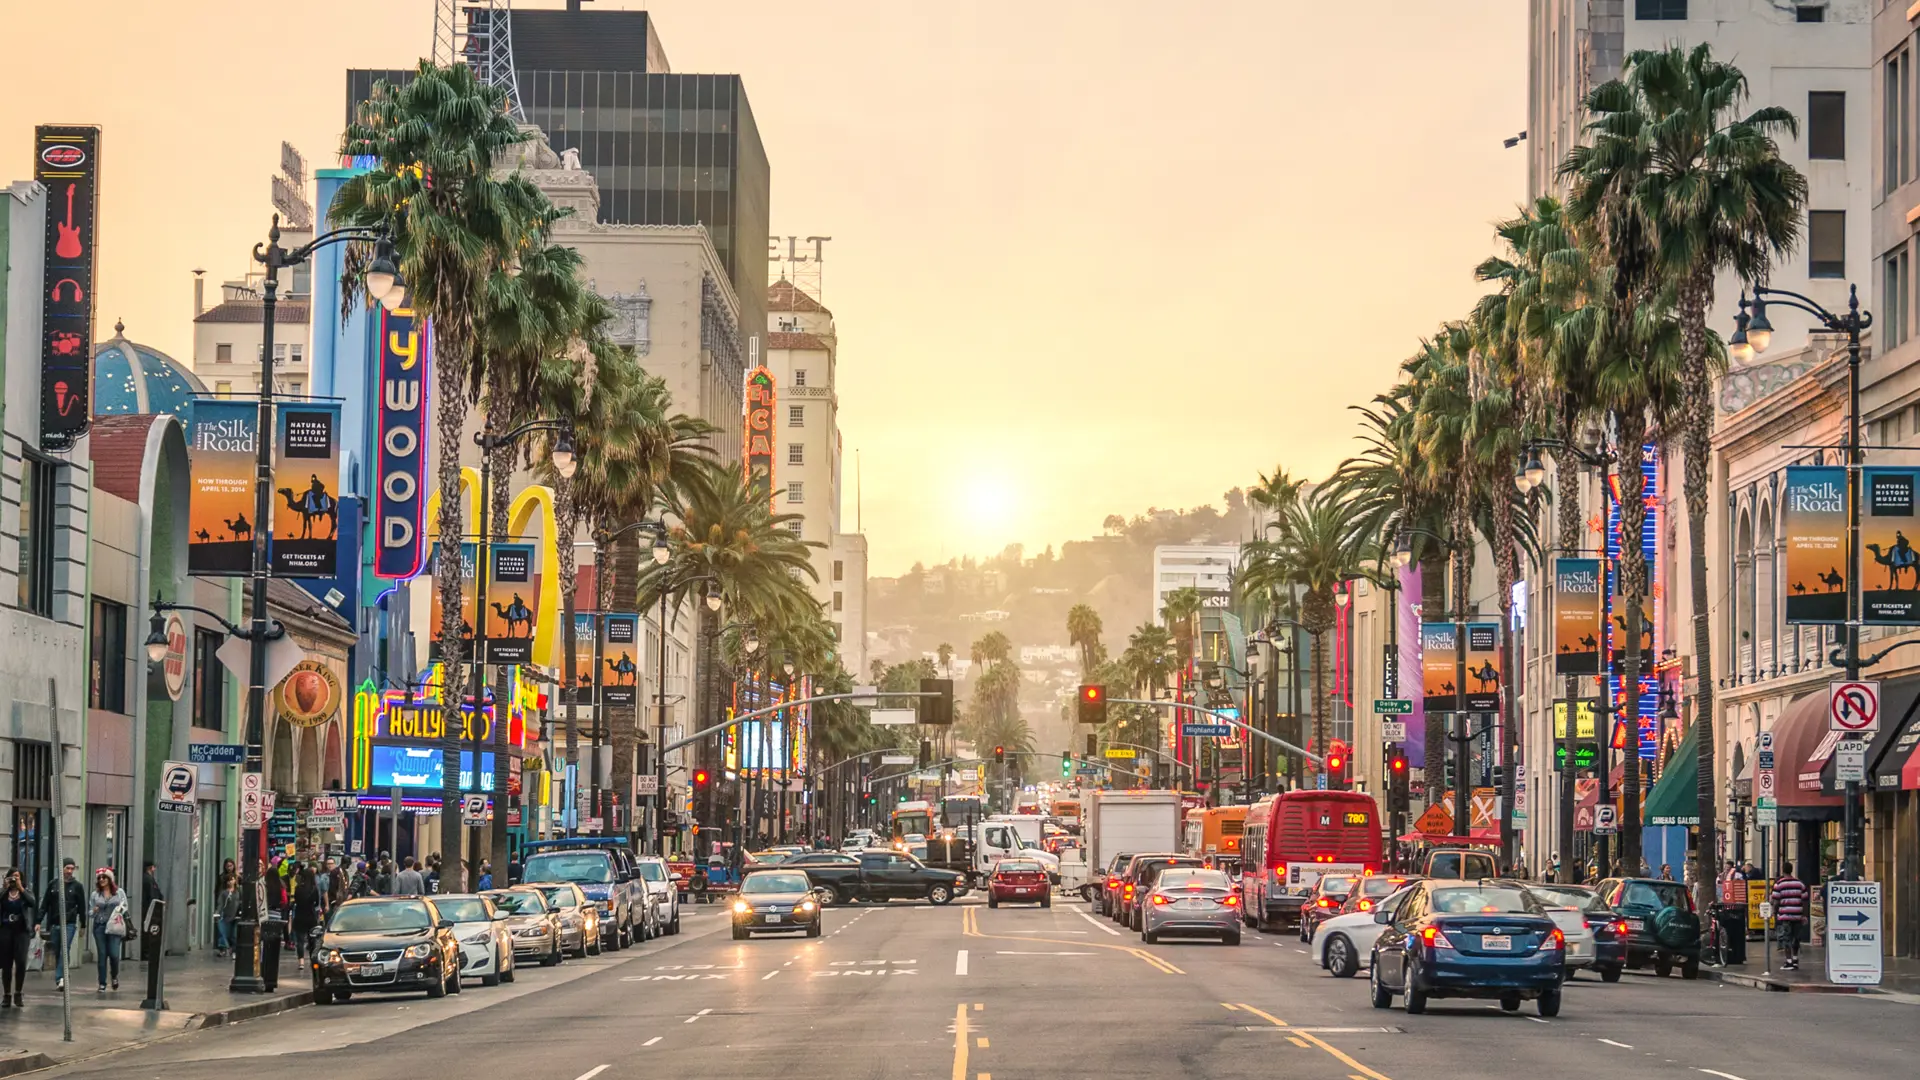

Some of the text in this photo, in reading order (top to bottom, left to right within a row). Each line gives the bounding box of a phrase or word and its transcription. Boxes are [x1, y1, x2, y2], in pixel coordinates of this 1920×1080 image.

[204, 420, 249, 438] The Silk
[203, 432, 254, 452] Road
[1797, 482, 1838, 500] The Silk
[1796, 494, 1843, 512] Road
[1572, 571, 1593, 584] Silk
[1563, 579, 1597, 593] Road
[1435, 632, 1452, 642] Silk
[1428, 639, 1455, 649] Road
[286, 711, 326, 725] Since 1989
[191, 745, 234, 755] McCadden
[175, 804, 192, 812] HERE
[314, 798, 335, 810] ATM
[1321, 816, 1330, 825] M
[1347, 814, 1365, 824] 780
